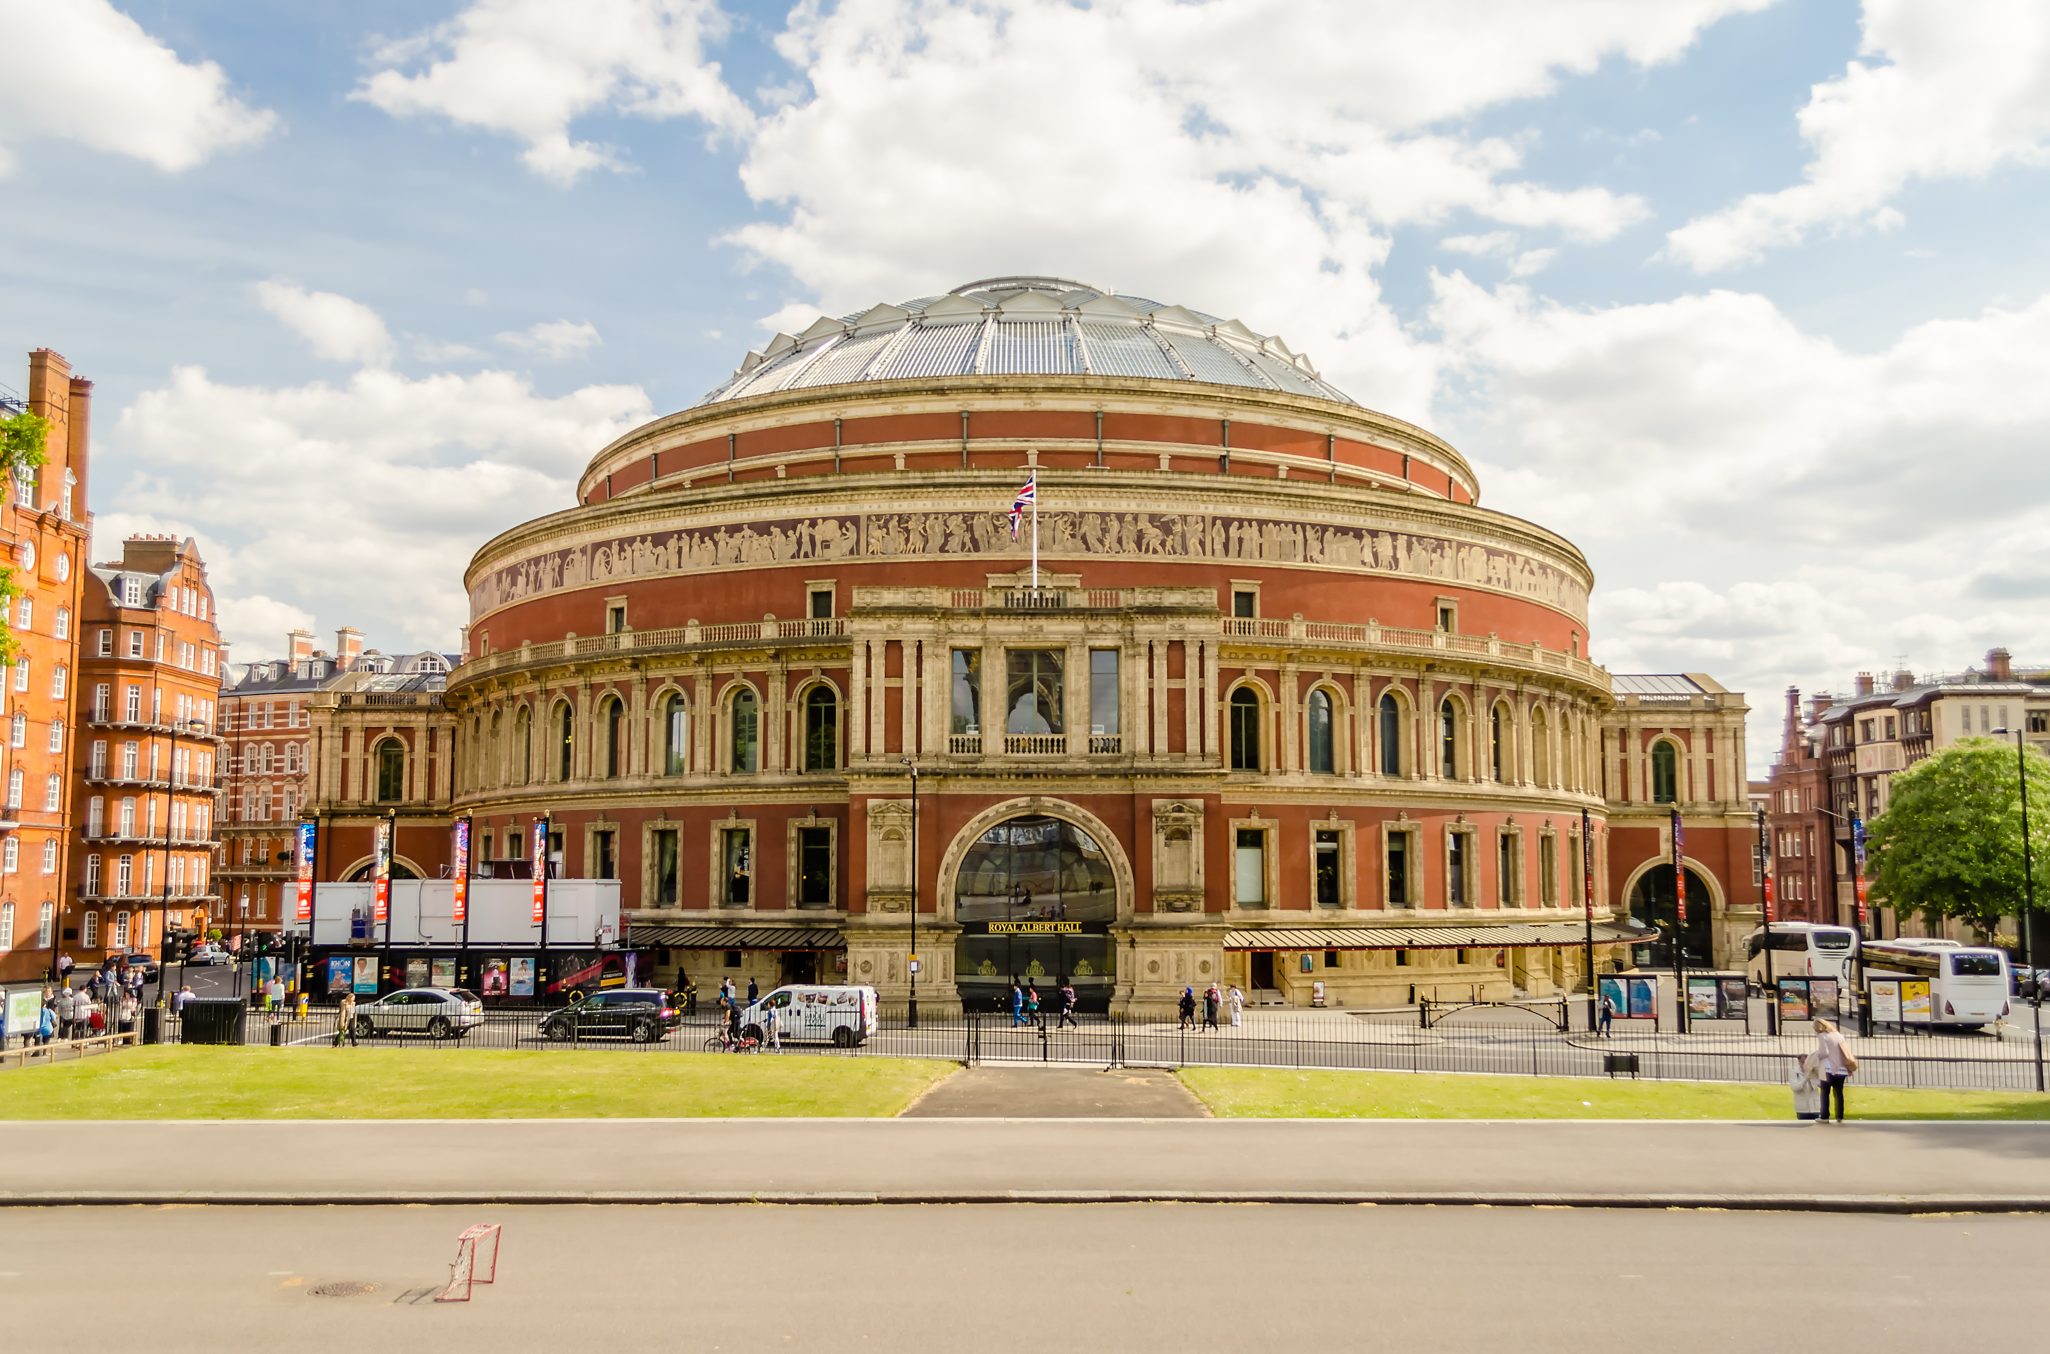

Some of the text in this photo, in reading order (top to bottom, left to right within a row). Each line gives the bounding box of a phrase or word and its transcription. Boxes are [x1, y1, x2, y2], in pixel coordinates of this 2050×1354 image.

[989, 923, 1082, 932] ROYAL ALBERT HALL
